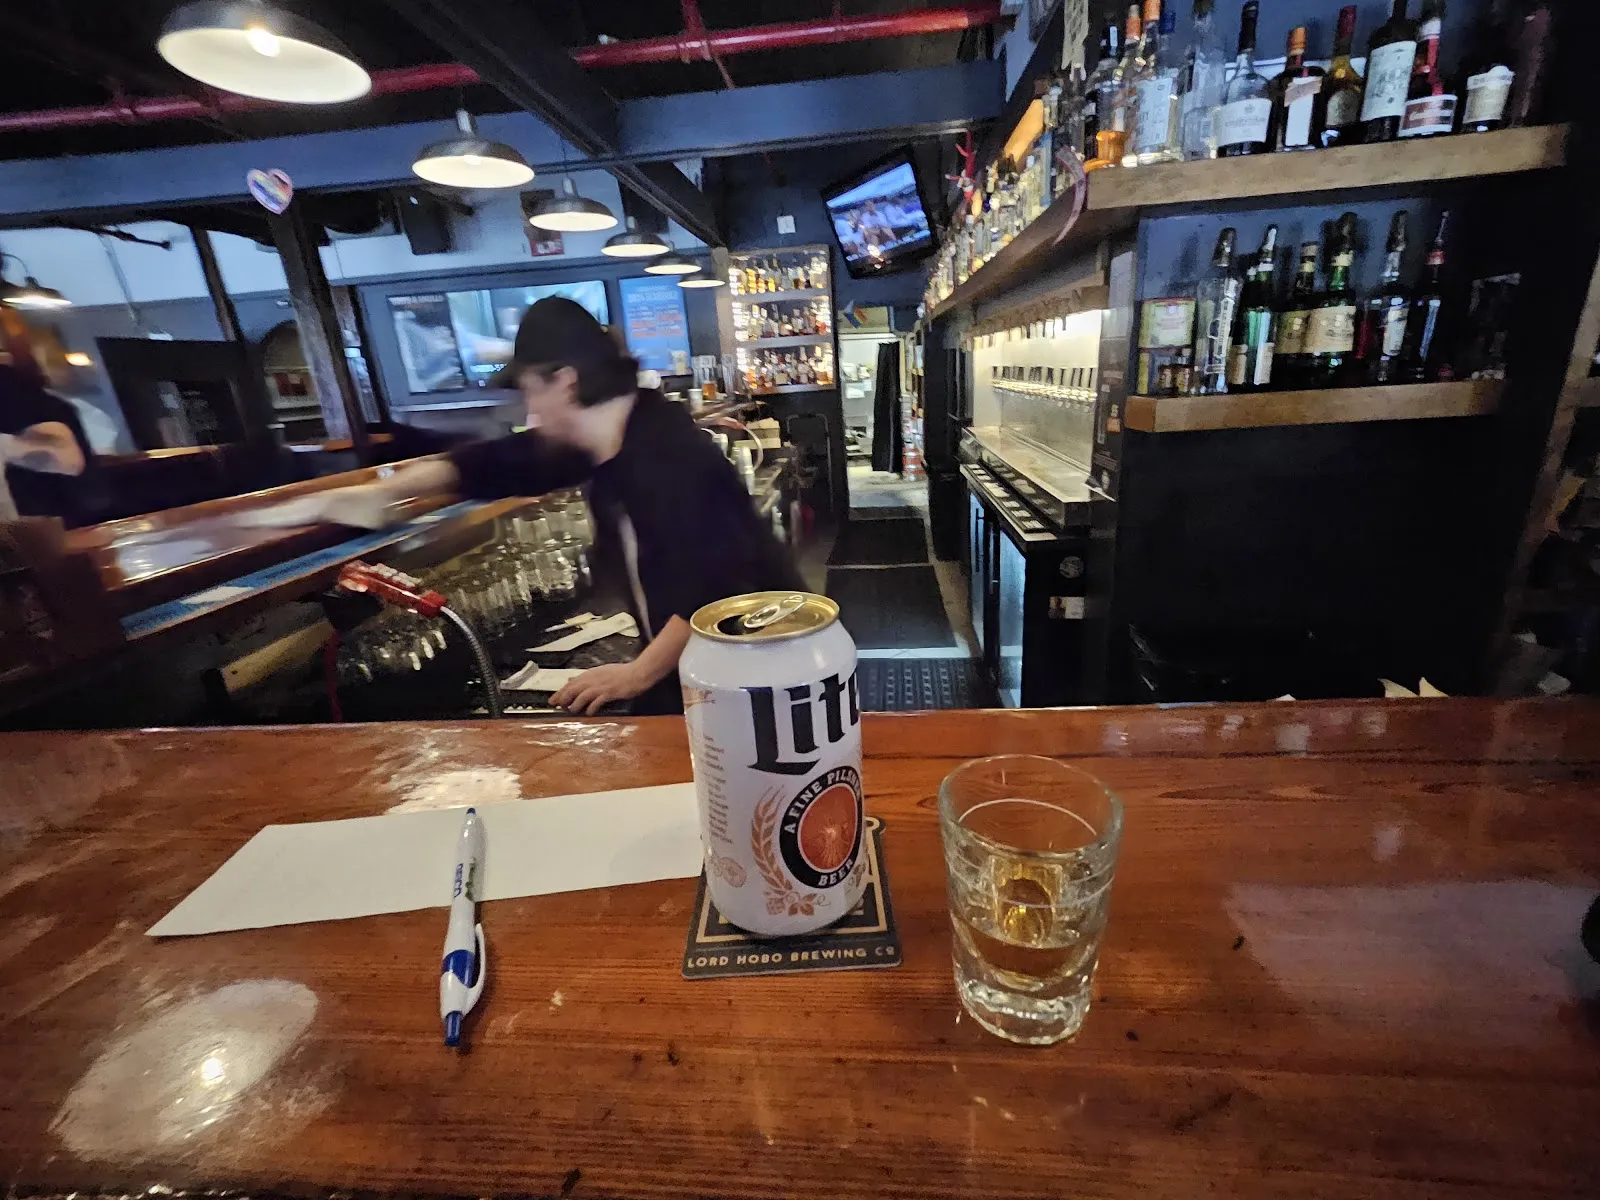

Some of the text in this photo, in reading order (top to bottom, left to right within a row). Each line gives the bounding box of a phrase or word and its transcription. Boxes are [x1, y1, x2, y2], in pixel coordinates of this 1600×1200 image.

[788, 781, 823, 817] FINE
[784, 823, 797, 834] A
[818, 859, 853, 886] BEER
[687, 956, 729, 968] LORD
[736, 952, 783, 965] HOBO
[790, 947, 867, 962] BREWING
